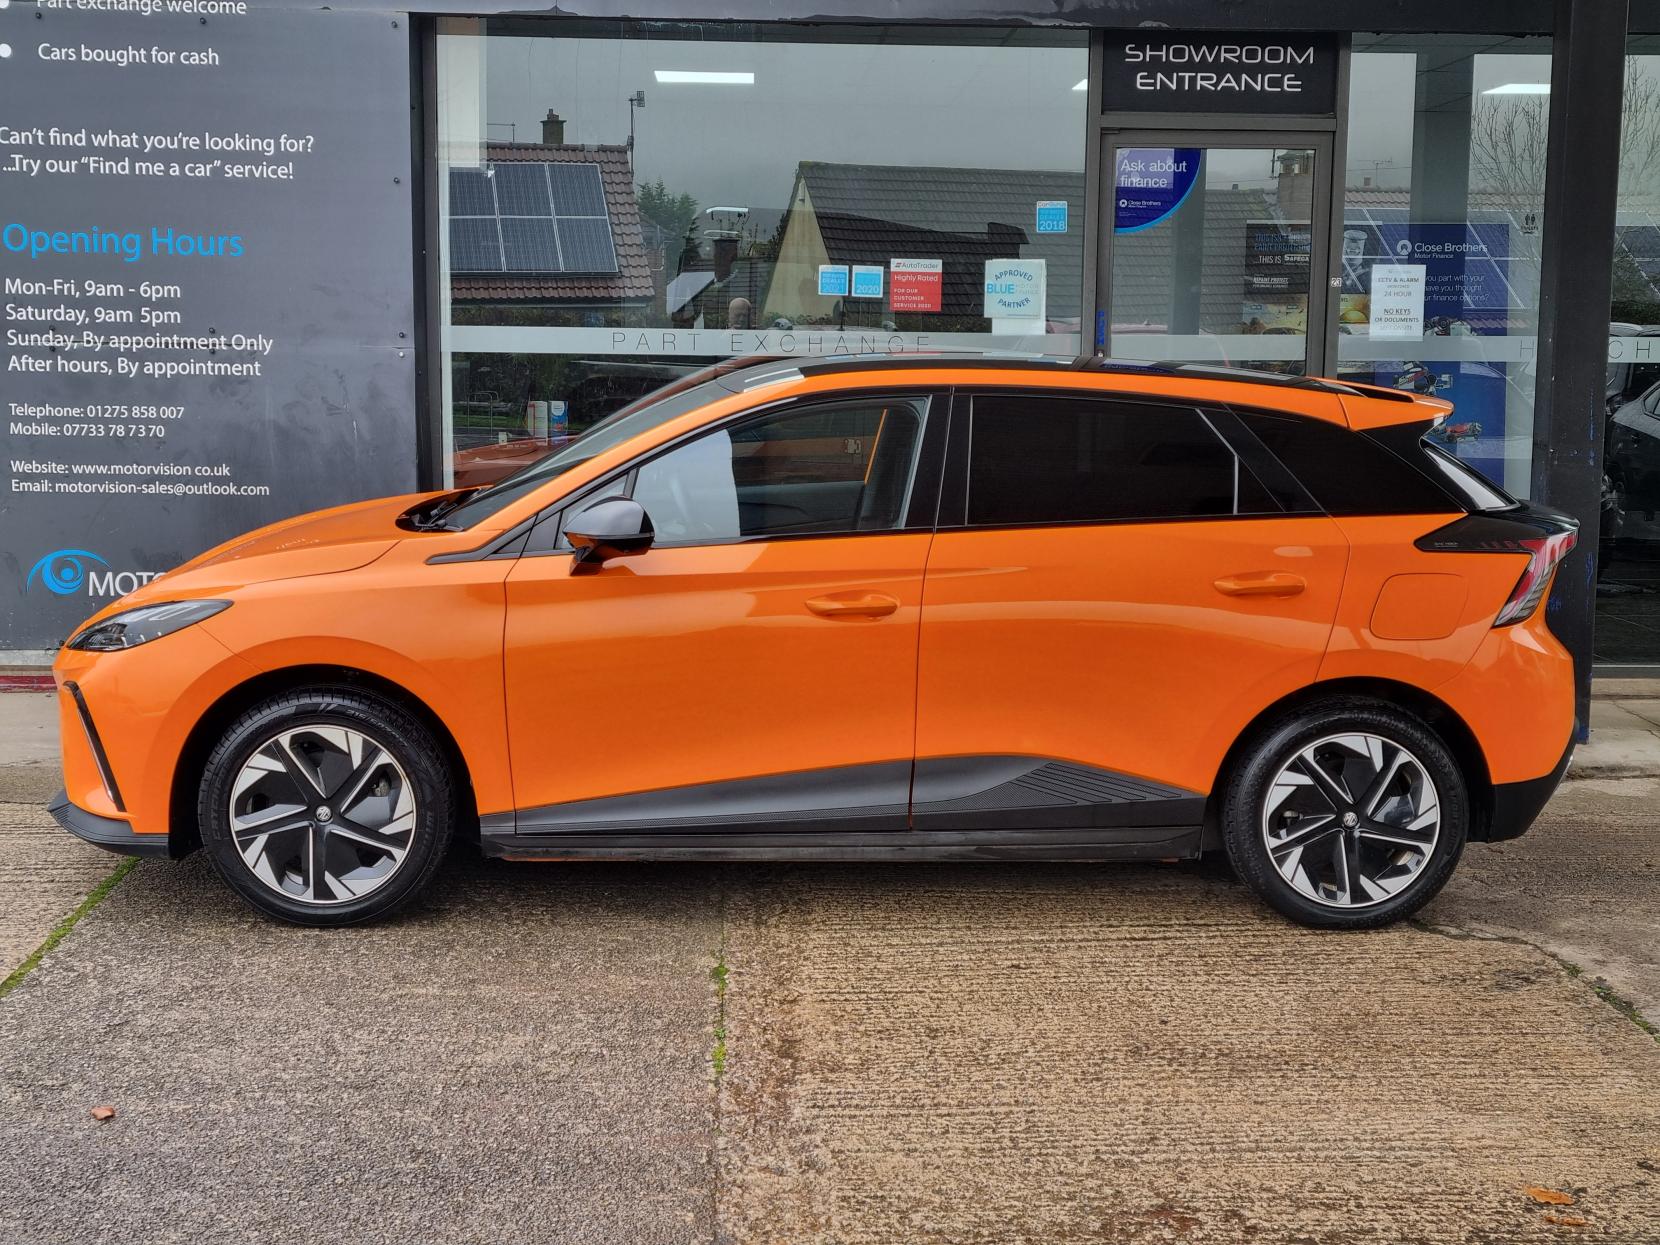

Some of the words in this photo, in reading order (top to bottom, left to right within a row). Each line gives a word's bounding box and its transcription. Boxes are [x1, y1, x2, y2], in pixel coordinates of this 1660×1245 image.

[76, 0, 162, 15] exchange
[167, 0, 247, 15] welcome
[38, 43, 77, 61] Cars
[81, 44, 147, 67] bought
[151, 47, 176, 64] for
[180, 48, 220, 65] cash
[1125, 44, 1314, 64] SHOWROOM
[1136, 72, 1302, 92] ENTRANCE
[0, 127, 45, 146] Can't
[49, 127, 86, 147] find
[91, 130, 139, 149] what
[143, 131, 201, 153] you're
[205, 132, 275, 156] looking
[279, 134, 314, 153] for?
[45, 160, 78, 174] our
[135, 163, 165, 176] me
[169, 164, 181, 177] a
[224, 161, 294, 180] service!
[1120, 159, 1146, 173] Ask
[1149, 160, 1188, 173] about
[1120, 175, 1168, 189] finance
[1039, 220, 1065, 231] 2018
[2, 223, 142, 263] Opening
[151, 226, 245, 257] Hours
[1414, 242, 1443, 252] Close
[1444, 242, 1488, 253] Brothers
[894, 274, 917, 282] Highly
[917, 274, 939, 282] Rated
[994, 269, 1033, 282] APPROVED
[1438, 274, 1452, 283] part
[1453, 273, 1469, 282] with
[4, 278, 80, 298] Mon-Fri,
[84, 280, 124, 297] 9am
[139, 281, 182, 301] 6pm
[986, 283, 1015, 295] BLUE
[1441, 285, 1454, 293] you
[997, 297, 1031, 309] PARTNER
[5, 303, 90, 325] Saturday,
[94, 307, 133, 323] 9am
[140, 307, 182, 327] 5pm
[7, 329, 79, 351] Sunday,
[82, 331, 105, 351] By
[109, 332, 227, 355] appointment
[231, 333, 274, 356] Only
[612, 331, 701, 351] PART
[730, 333, 930, 353] EXCHANGE
[8, 354, 53, 373] After
[57, 356, 112, 377] hours,
[117, 357, 139, 378] By
[143, 358, 262, 379] appointment
[8, 403, 85, 419] Telephone:
[86, 405, 129, 419] 01275
[131, 405, 158, 419] 858
[159, 406, 185, 419] 007
[9, 422, 61, 437] Mobile:
[63, 423, 105, 437] 07733
[108, 423, 126, 437] 78
[10, 460, 70, 475] Website:
[11, 479, 53, 493] Email:
[55, 479, 270, 497] motorvision-sales@outlook.com
[88, 571, 168, 597] MOT
